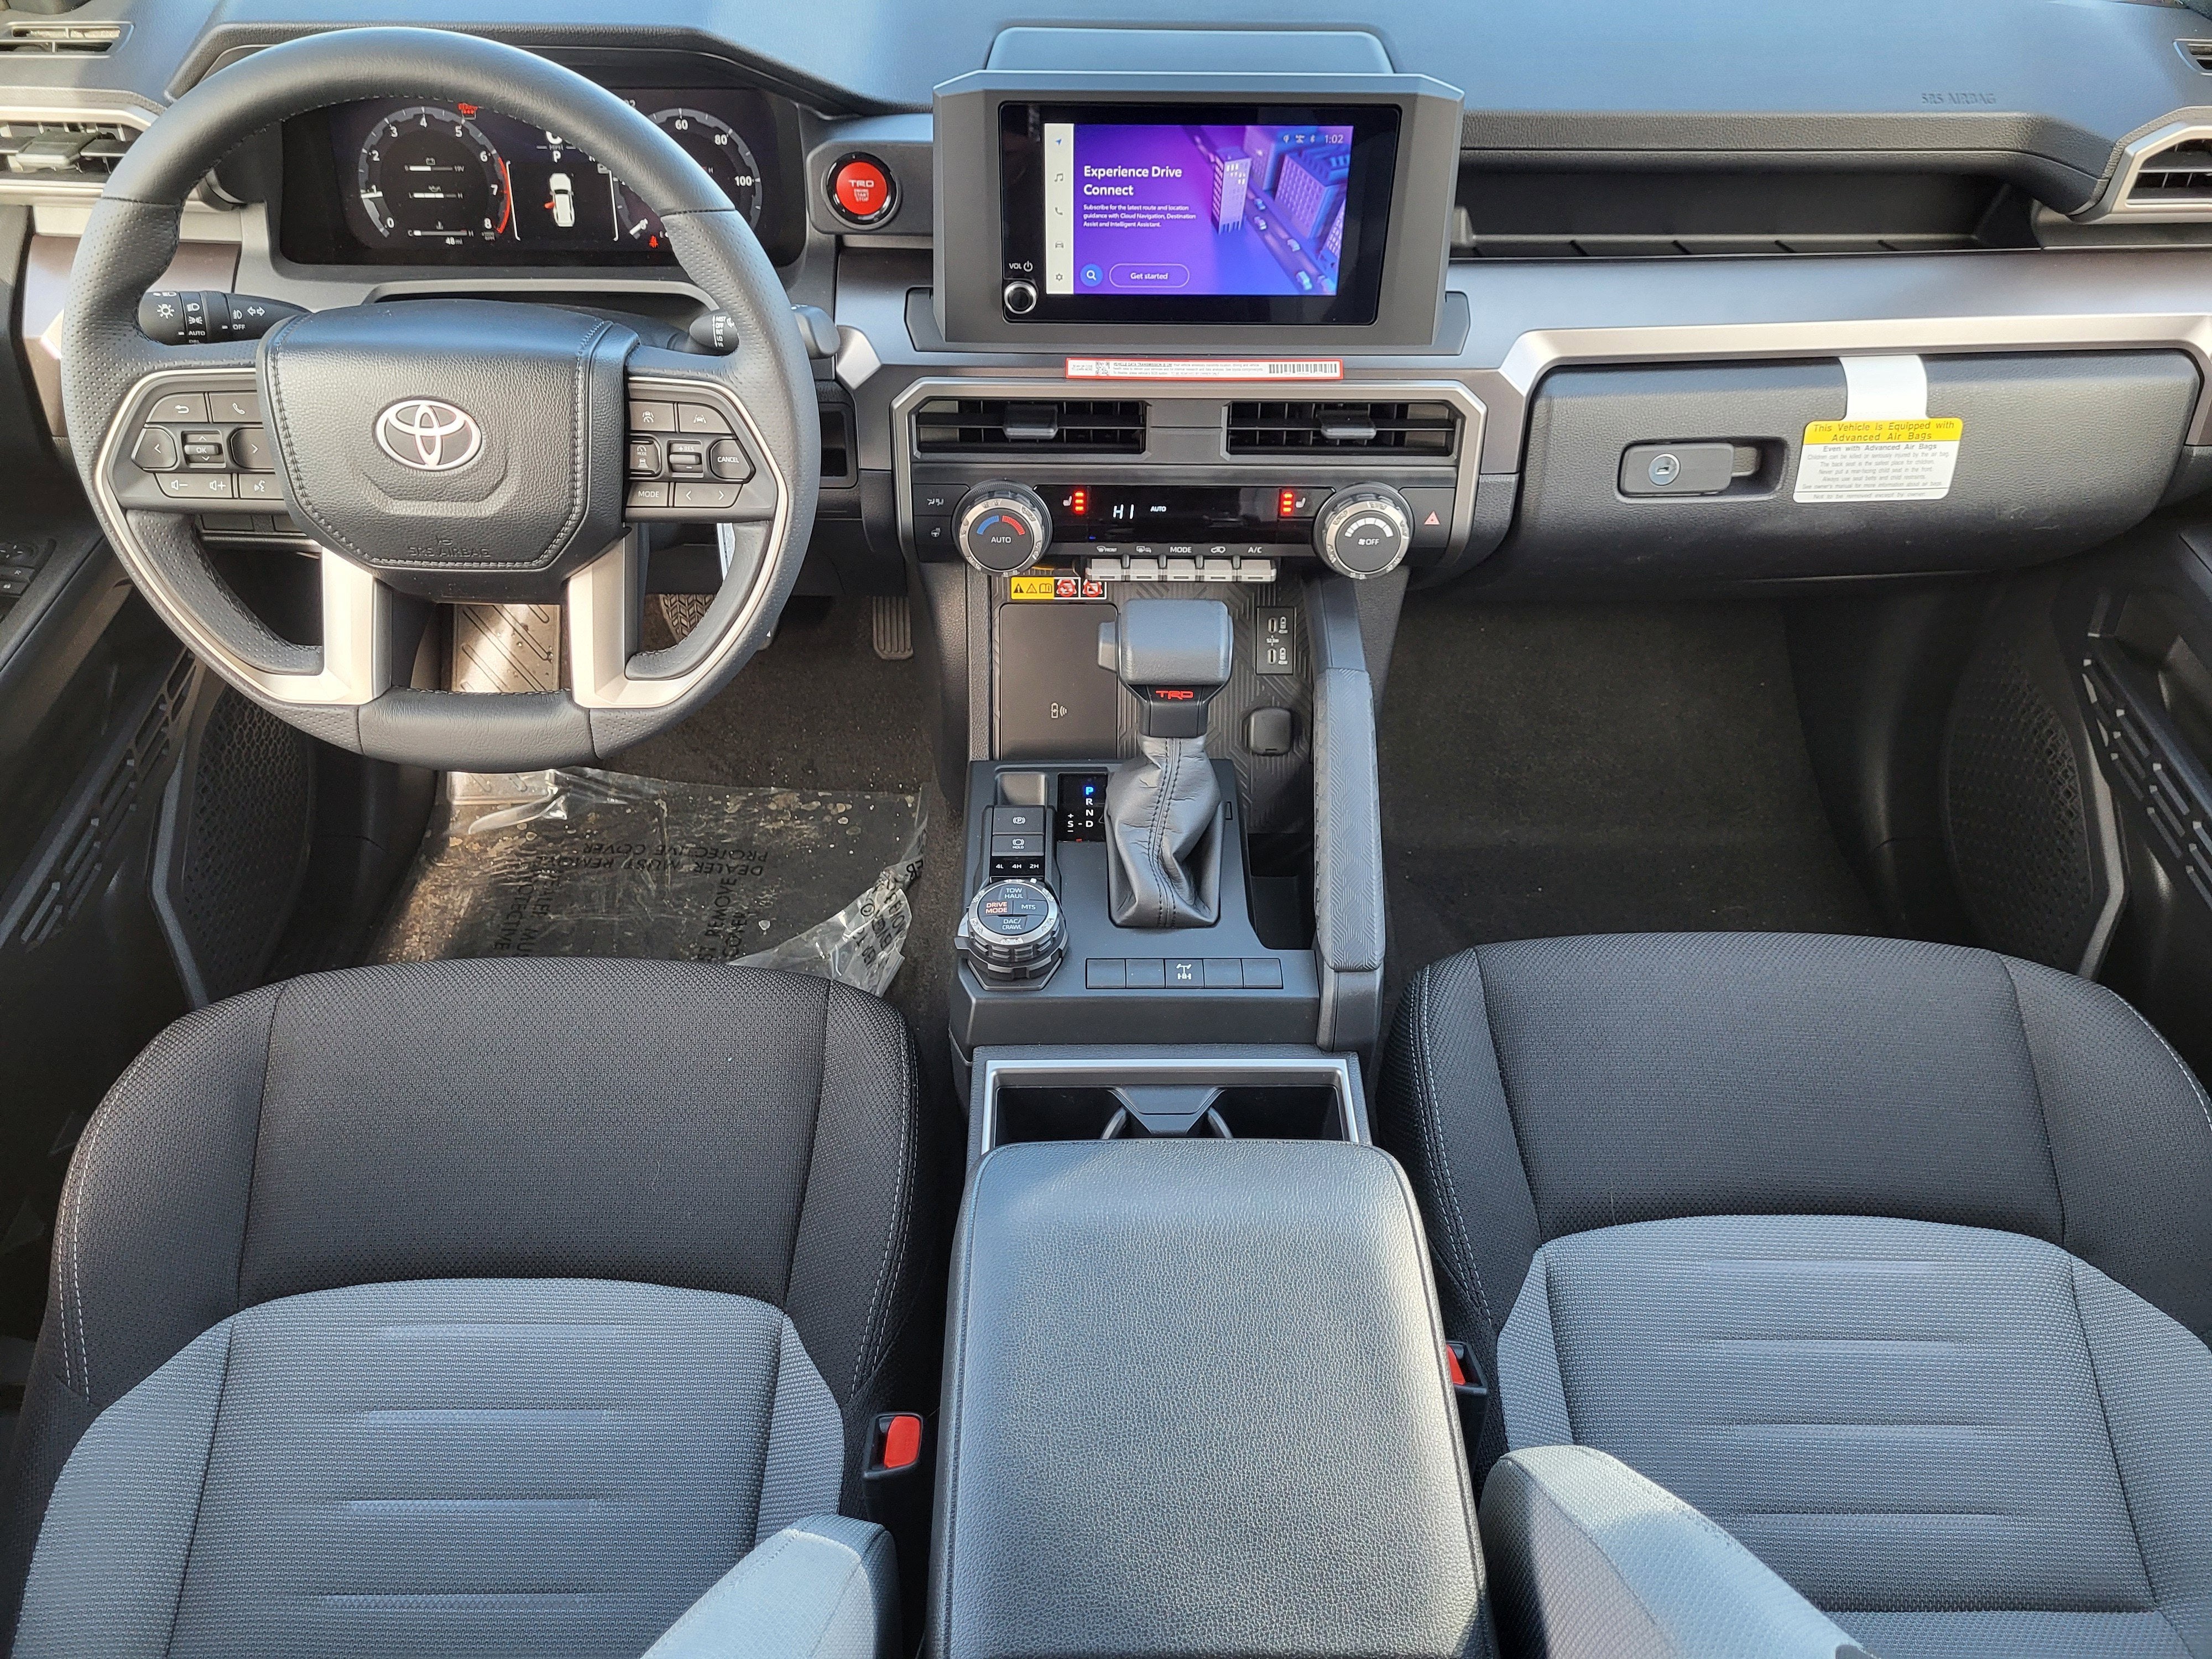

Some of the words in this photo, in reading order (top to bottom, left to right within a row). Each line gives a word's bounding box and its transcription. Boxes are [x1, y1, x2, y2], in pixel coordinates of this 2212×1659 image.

[1921, 93, 1944, 105] SRS
[1948, 92, 1997, 105] AIRBAG
[420, 116, 427, 128] 4
[675, 119, 689, 131] 60
[390, 126, 398, 138] 3
[455, 126, 463, 138] 5
[714, 134, 728, 145] 80
[1324, 134, 1344, 144] 1:02
[372, 149, 380, 161] 2
[479, 150, 488, 162] 6
[552, 150, 561, 163] P
[1083, 165, 1149, 180] Experience
[1151, 165, 1182, 178] Drive
[734, 175, 752, 187] 100
[848, 179, 875, 188] TRD
[491, 184, 498, 196] 7
[1083, 184, 1134, 196] Connect
[387, 217, 395, 228] 0
[1136, 212, 1166, 221] Navigation,
[484, 217, 492, 229] 8
[1130, 272, 1143, 280] Get
[1814, 424, 1833, 432] This
[1838, 422, 1870, 431] Vehicle
[1875, 422, 1883, 431] is
[1888, 421, 1931, 431] Equipped
[1936, 421, 1955, 429] with
[1831, 433, 1881, 442] Advanced
[1886, 432, 1902, 441] Air
[1908, 431, 1932, 441] Bags
[1918, 443, 1937, 451] Bags
[990, 535, 1012, 544] AUTO
[1155, 690, 1194, 700] TRD
[1086, 786, 1094, 795] P
[582, 843, 646, 856] COVER
[695, 862, 763, 877] DEALER
